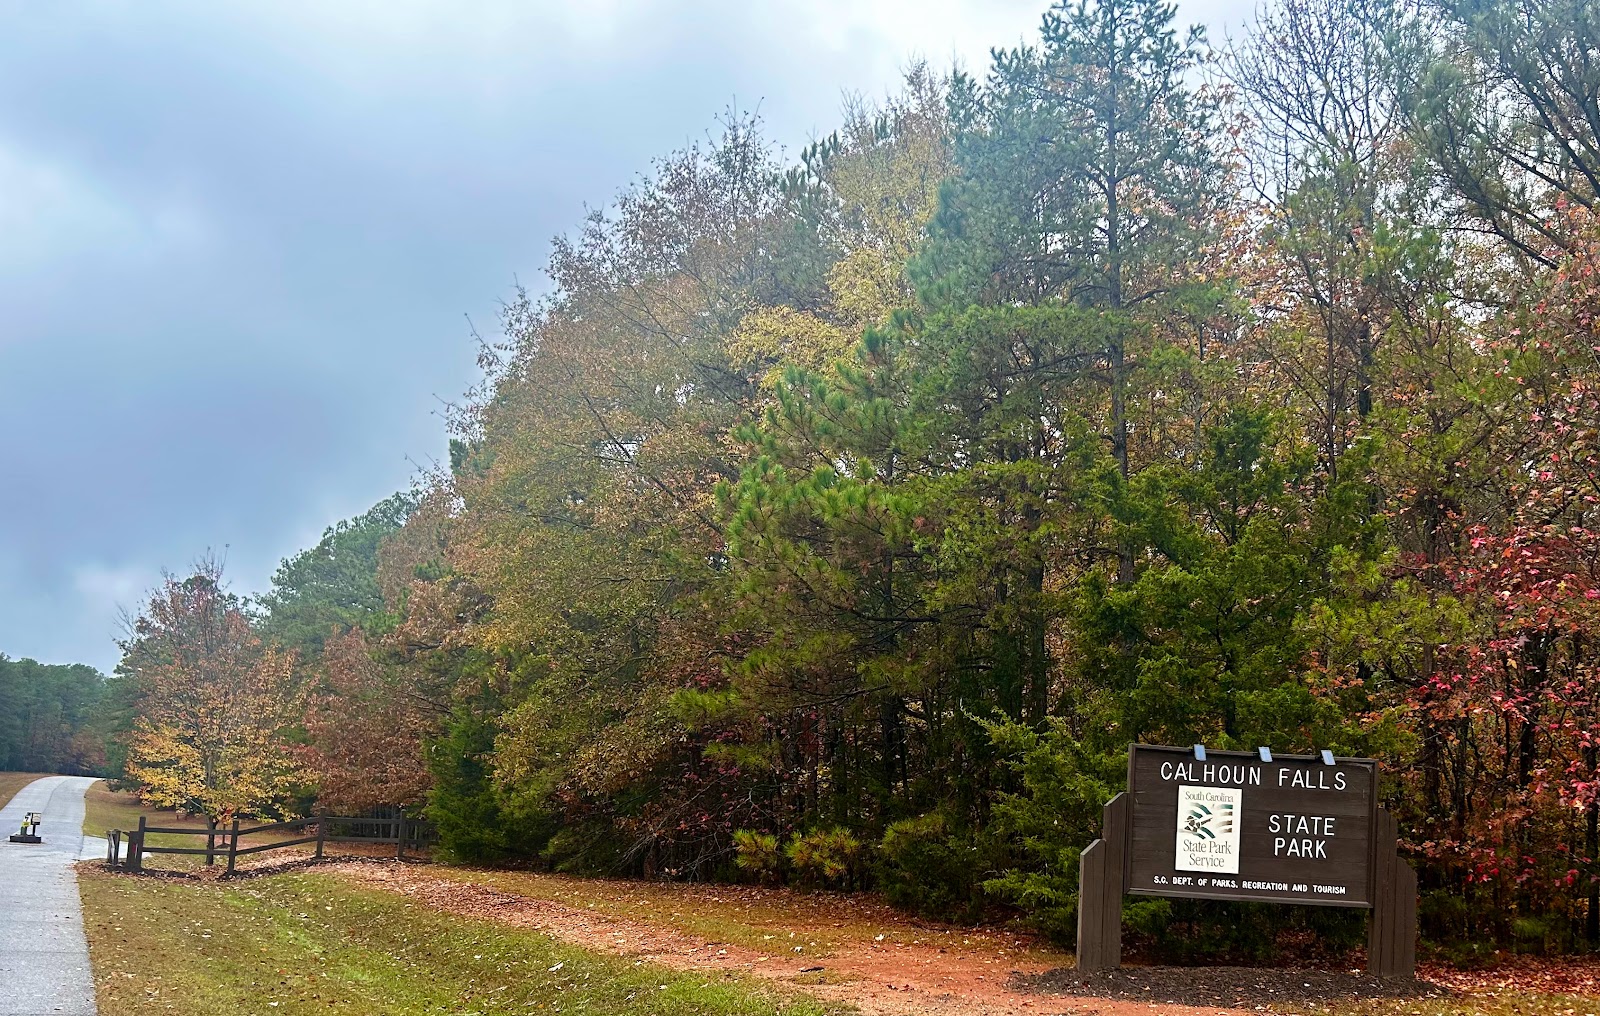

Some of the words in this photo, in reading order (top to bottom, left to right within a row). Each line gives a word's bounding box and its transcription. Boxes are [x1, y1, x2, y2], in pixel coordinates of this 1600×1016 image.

[1160, 761, 1261, 786] CALHOUN
[1278, 767, 1347, 791] FALLS
[1185, 791, 1205, 801] South
[1205, 792, 1234, 802] Carolina
[1268, 814, 1336, 837] STATE
[1183, 839, 1207, 853] State
[1209, 840, 1232, 854] Park
[1274, 837, 1327, 859] PARK
[1189, 853, 1225, 868] Service
[1153, 875, 1168, 885] S.C.
[1172, 876, 1194, 886] DEPT.
[1197, 878, 1208, 887] OF
[1242, 881, 1288, 892] RECREATION
[1292, 883, 1308, 893] AND
[1312, 884, 1346, 895] TOURISM
